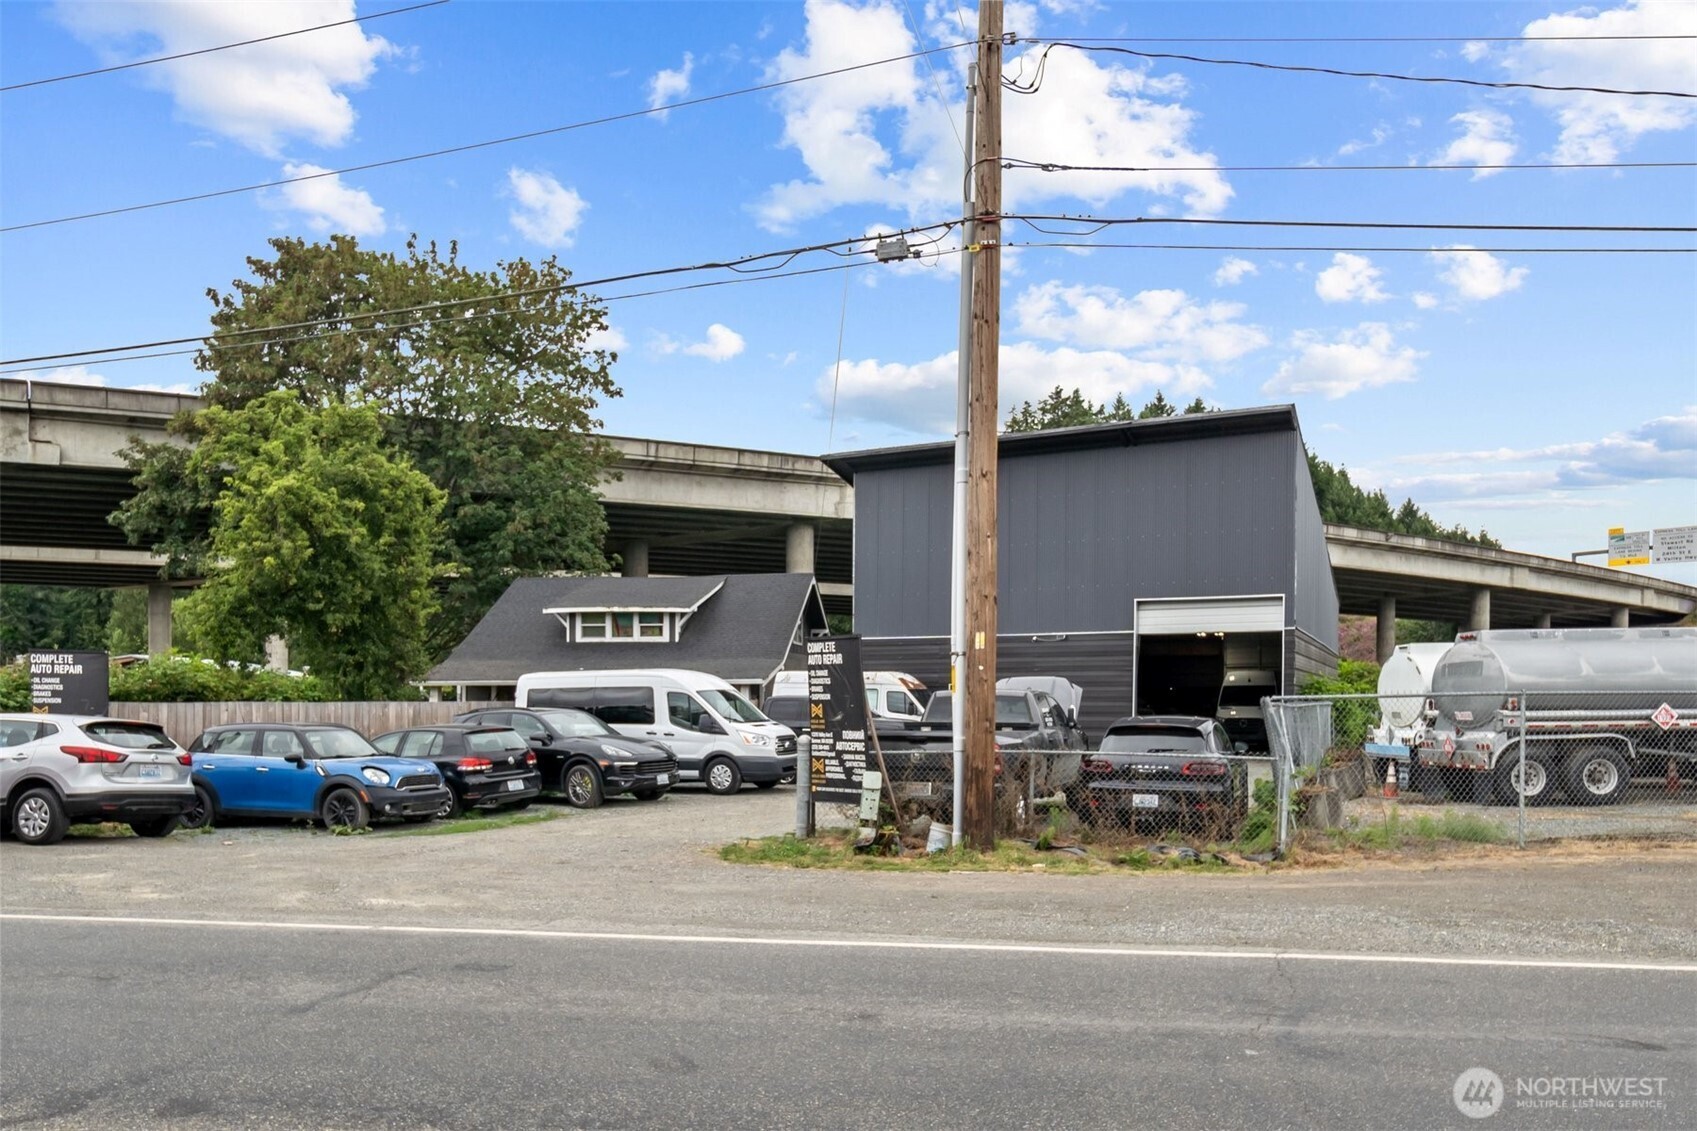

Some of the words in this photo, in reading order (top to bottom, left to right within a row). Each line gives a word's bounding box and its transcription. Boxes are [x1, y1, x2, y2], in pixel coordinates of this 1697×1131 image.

[807, 641, 836, 653] COMPLETE
[30, 653, 74, 664] COMPLETE
[808, 654, 822, 665] AUTO
[822, 653, 843, 665] REPAIR
[30, 664, 52, 674] AUTO
[54, 664, 83, 675] REPAIR
